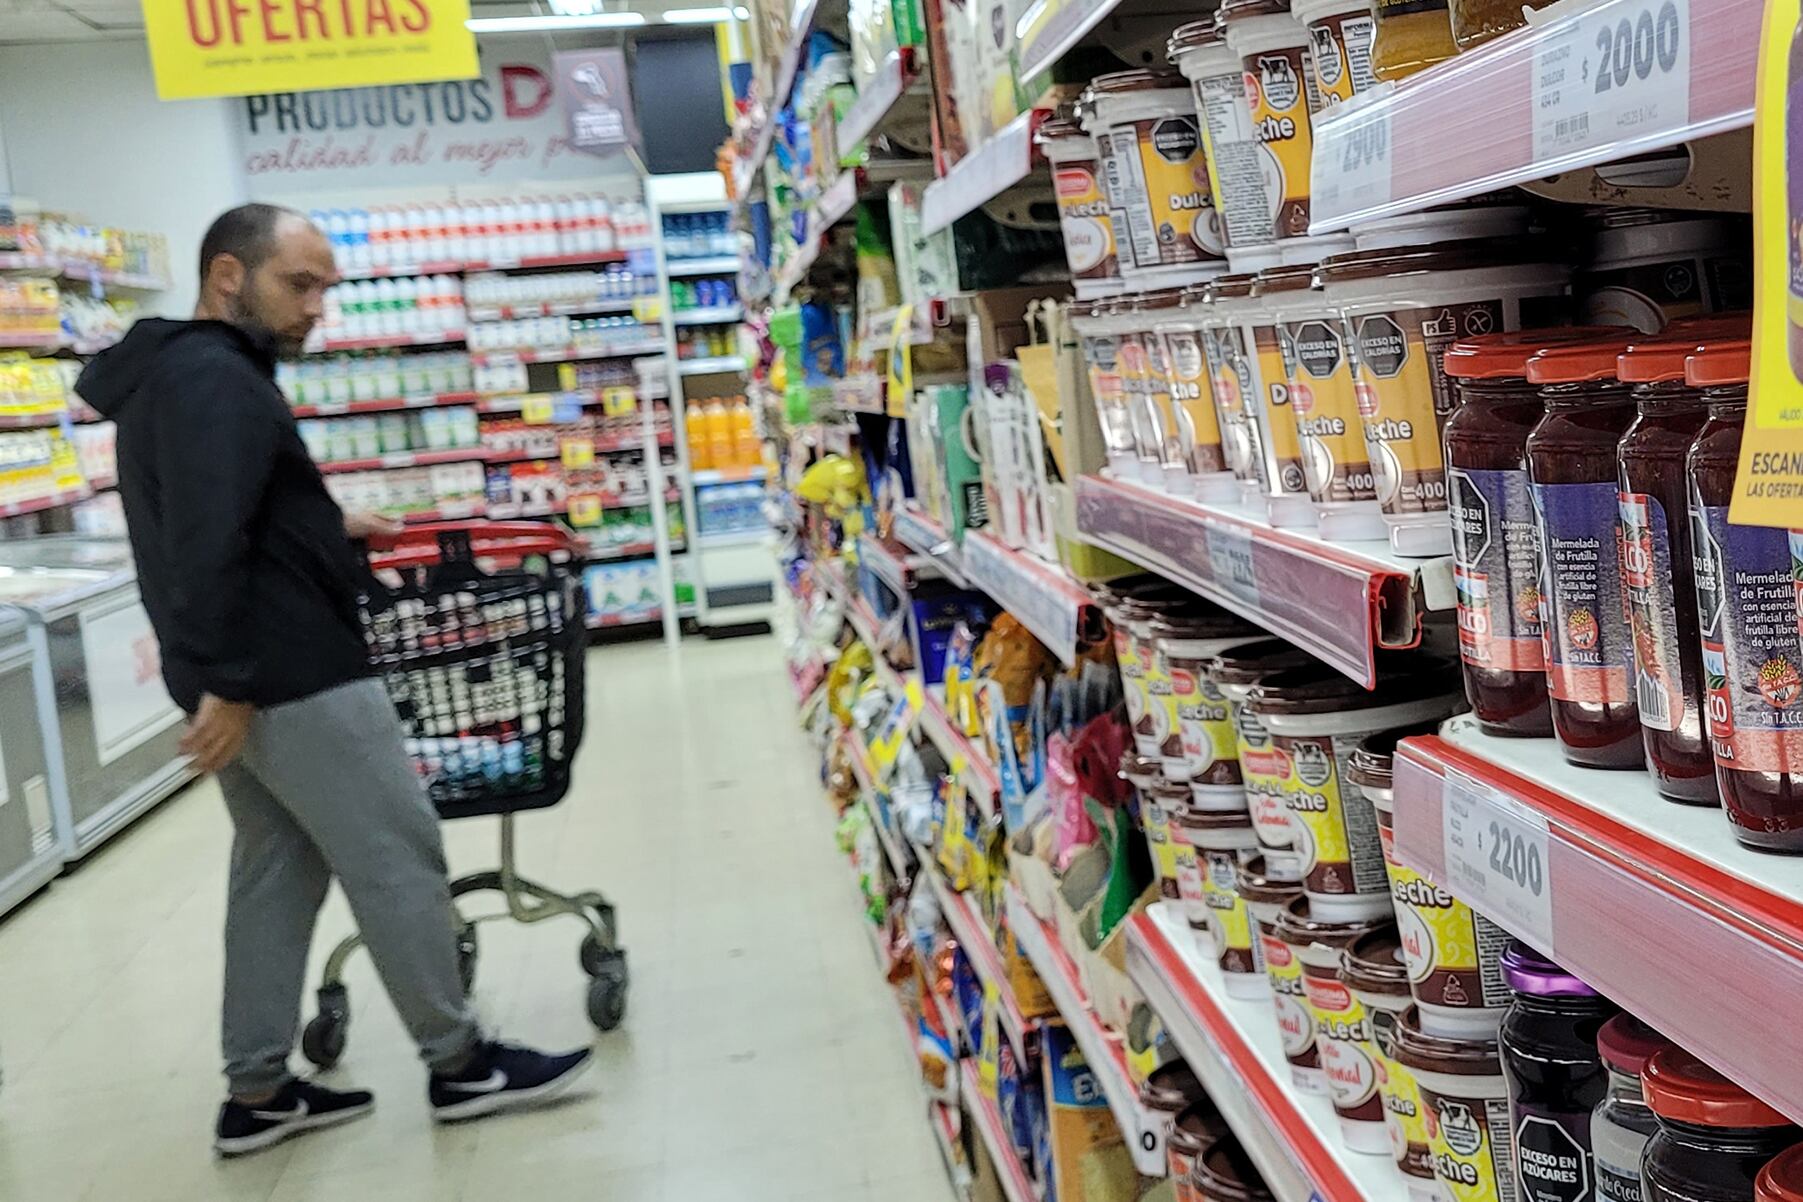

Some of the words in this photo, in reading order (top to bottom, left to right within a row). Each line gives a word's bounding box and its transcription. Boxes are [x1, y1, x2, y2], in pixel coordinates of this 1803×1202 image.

[184, 0, 434, 47] OFERTAS
[1595, 1, 1679, 94] 2000
[247, 78, 493, 134] PRODUCTOS
[246, 136, 374, 177] calidad
[390, 130, 431, 166] al
[443, 134, 532, 177] mejor
[1169, 192, 1214, 211] Dulc
[1071, 202, 1110, 218] Lech
[1751, 453, 1803, 475] ESCAN
[1346, 473, 1374, 491] 400
[1414, 482, 1445, 500] 400
[1747, 483, 1765, 497] LAS
[1469, 508, 1482, 520] EN
[1551, 538, 1599, 549] Mermelada
[1555, 552, 1565, 561] de
[1567, 551, 1597, 561] Frutilla
[1569, 563, 1595, 571] esencia
[1703, 558, 1715, 572] EN
[1586, 572, 1596, 580] de
[1735, 570, 1793, 584] Mermelad
[1580, 581, 1597, 590] libre
[1572, 591, 1595, 602] gluten
[1740, 587, 1754, 599] de
[1742, 604, 1758, 612] con
[1760, 602, 1796, 611] esencia
[1745, 613, 1782, 624] artificial
[1784, 612, 1797, 622] de
[1744, 625, 1774, 635] frutilla
[1776, 624, 1798, 634] libre
[1751, 638, 1763, 648] de
[1765, 637, 1797, 650] gluten
[1711, 693, 1728, 723] CO
[1489, 821, 1542, 897] 2200
[1520, 1145, 1557, 1166] EXCESO
[1558, 1156, 1577, 1169] EN
[1522, 1162, 1577, 1184] AZÚCARES
